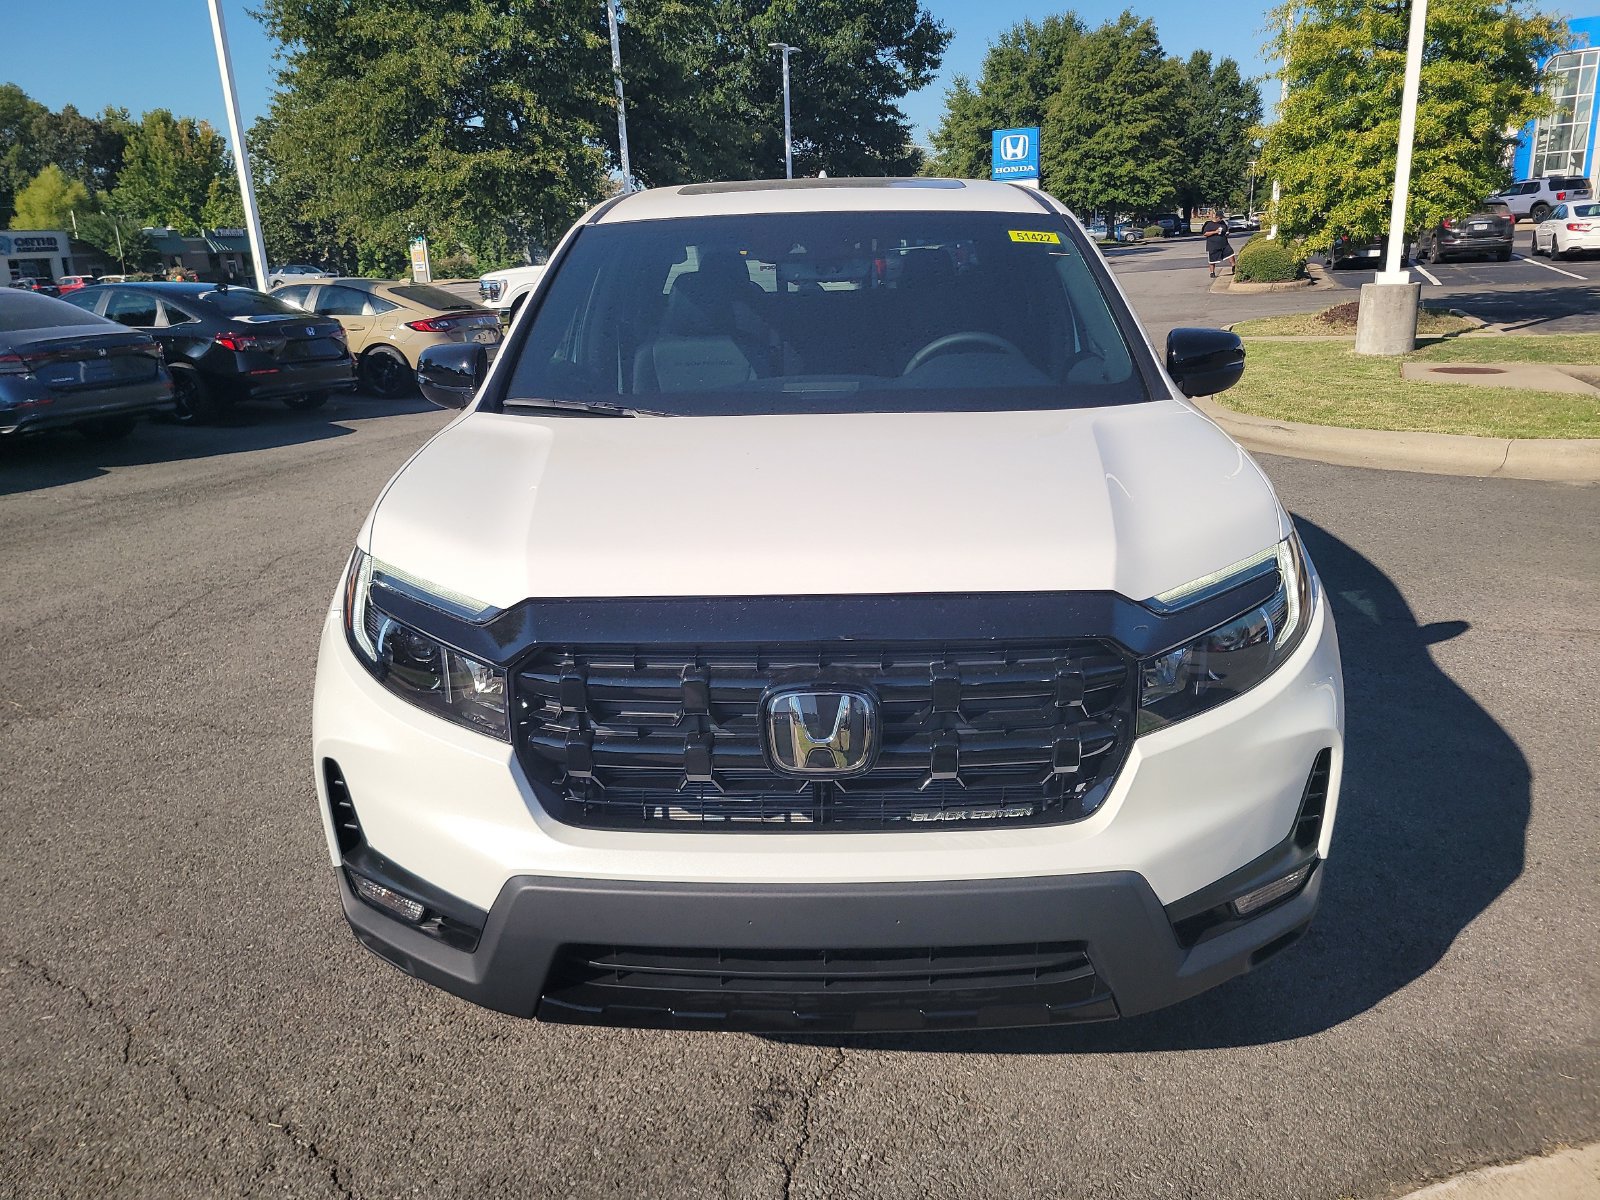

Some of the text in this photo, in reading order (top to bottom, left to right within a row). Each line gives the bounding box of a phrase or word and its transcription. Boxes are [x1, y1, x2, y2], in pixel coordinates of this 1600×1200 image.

[995, 165, 1036, 173] HONDA
[1017, 232, 1052, 242] 51422
[912, 808, 1033, 822] BLACK EDITION
